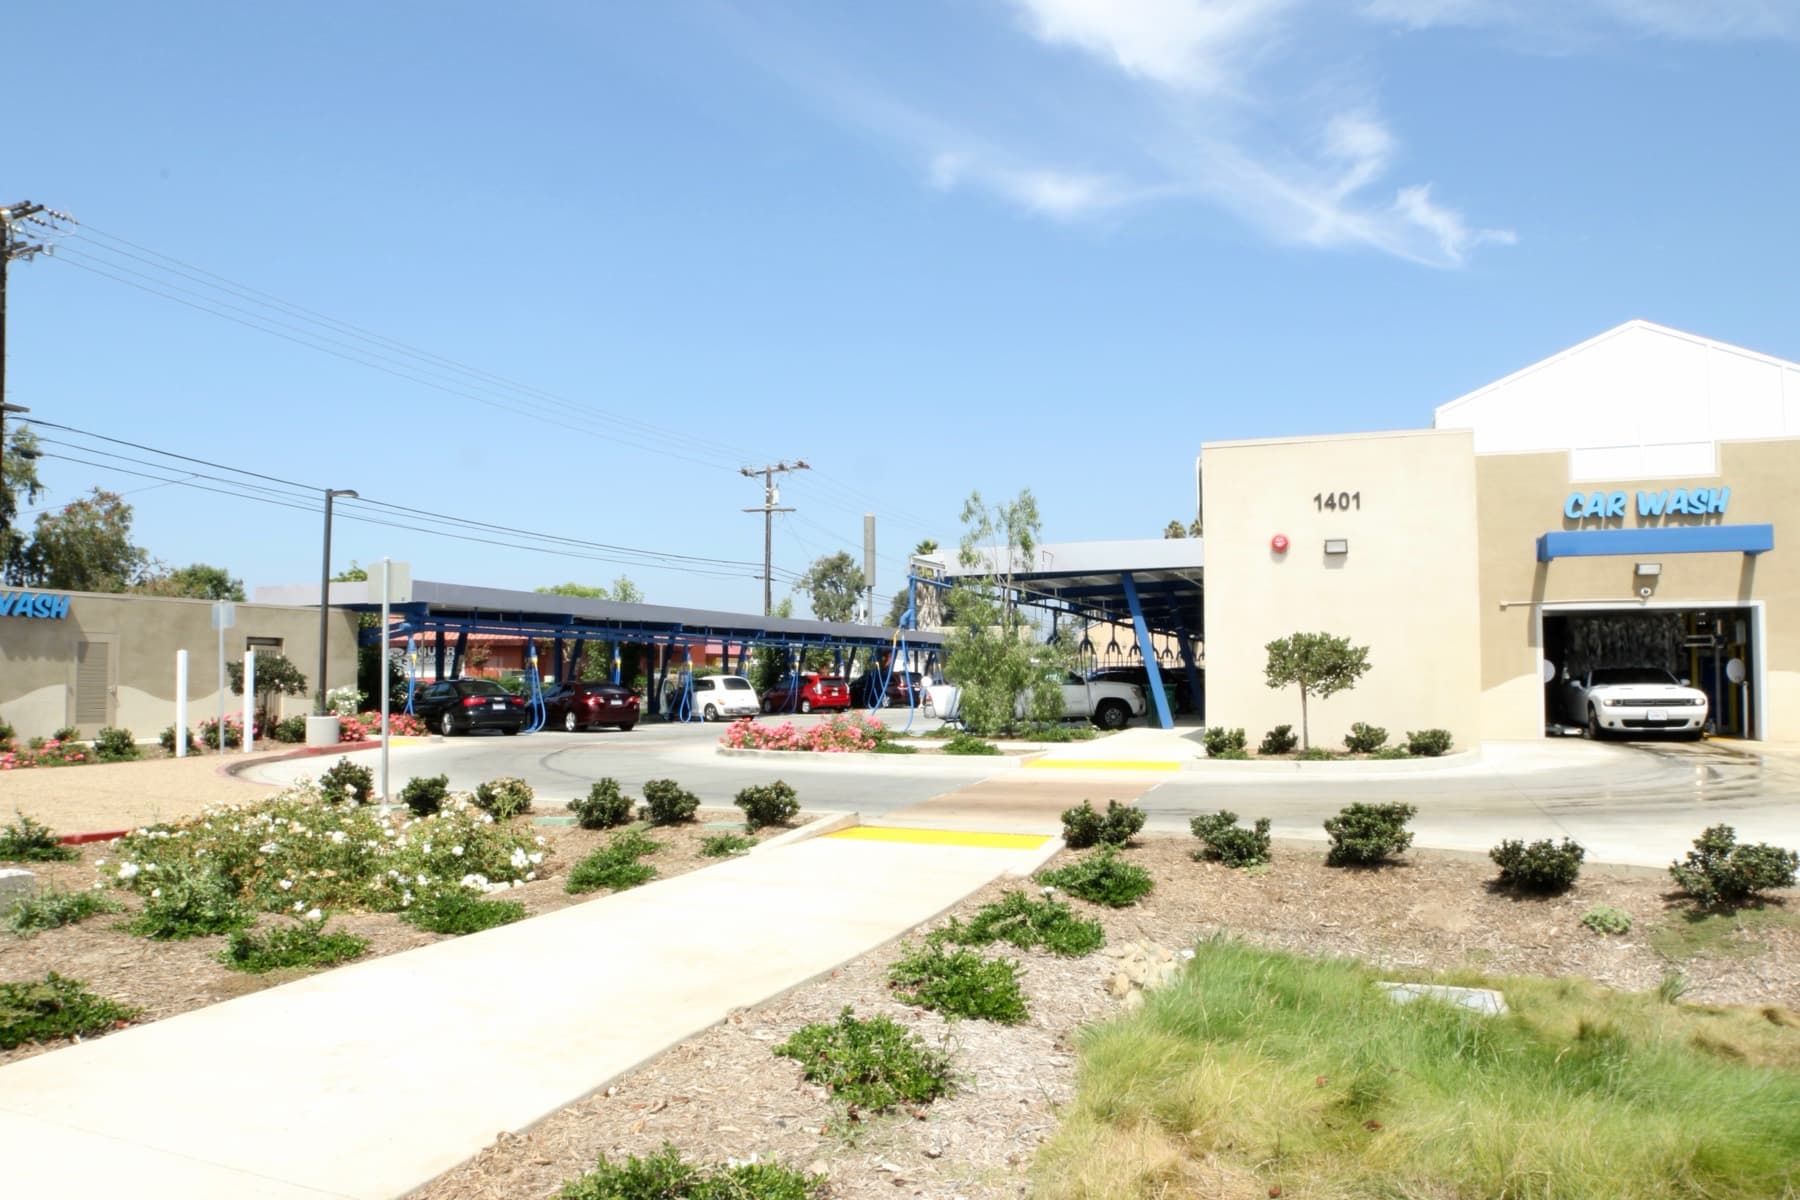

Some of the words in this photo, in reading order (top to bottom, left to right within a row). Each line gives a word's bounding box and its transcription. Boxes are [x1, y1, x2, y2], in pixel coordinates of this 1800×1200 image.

[1313, 491, 1361, 512] 1401
[1564, 491, 1626, 519] CAR
[1637, 486, 1730, 517] WASH
